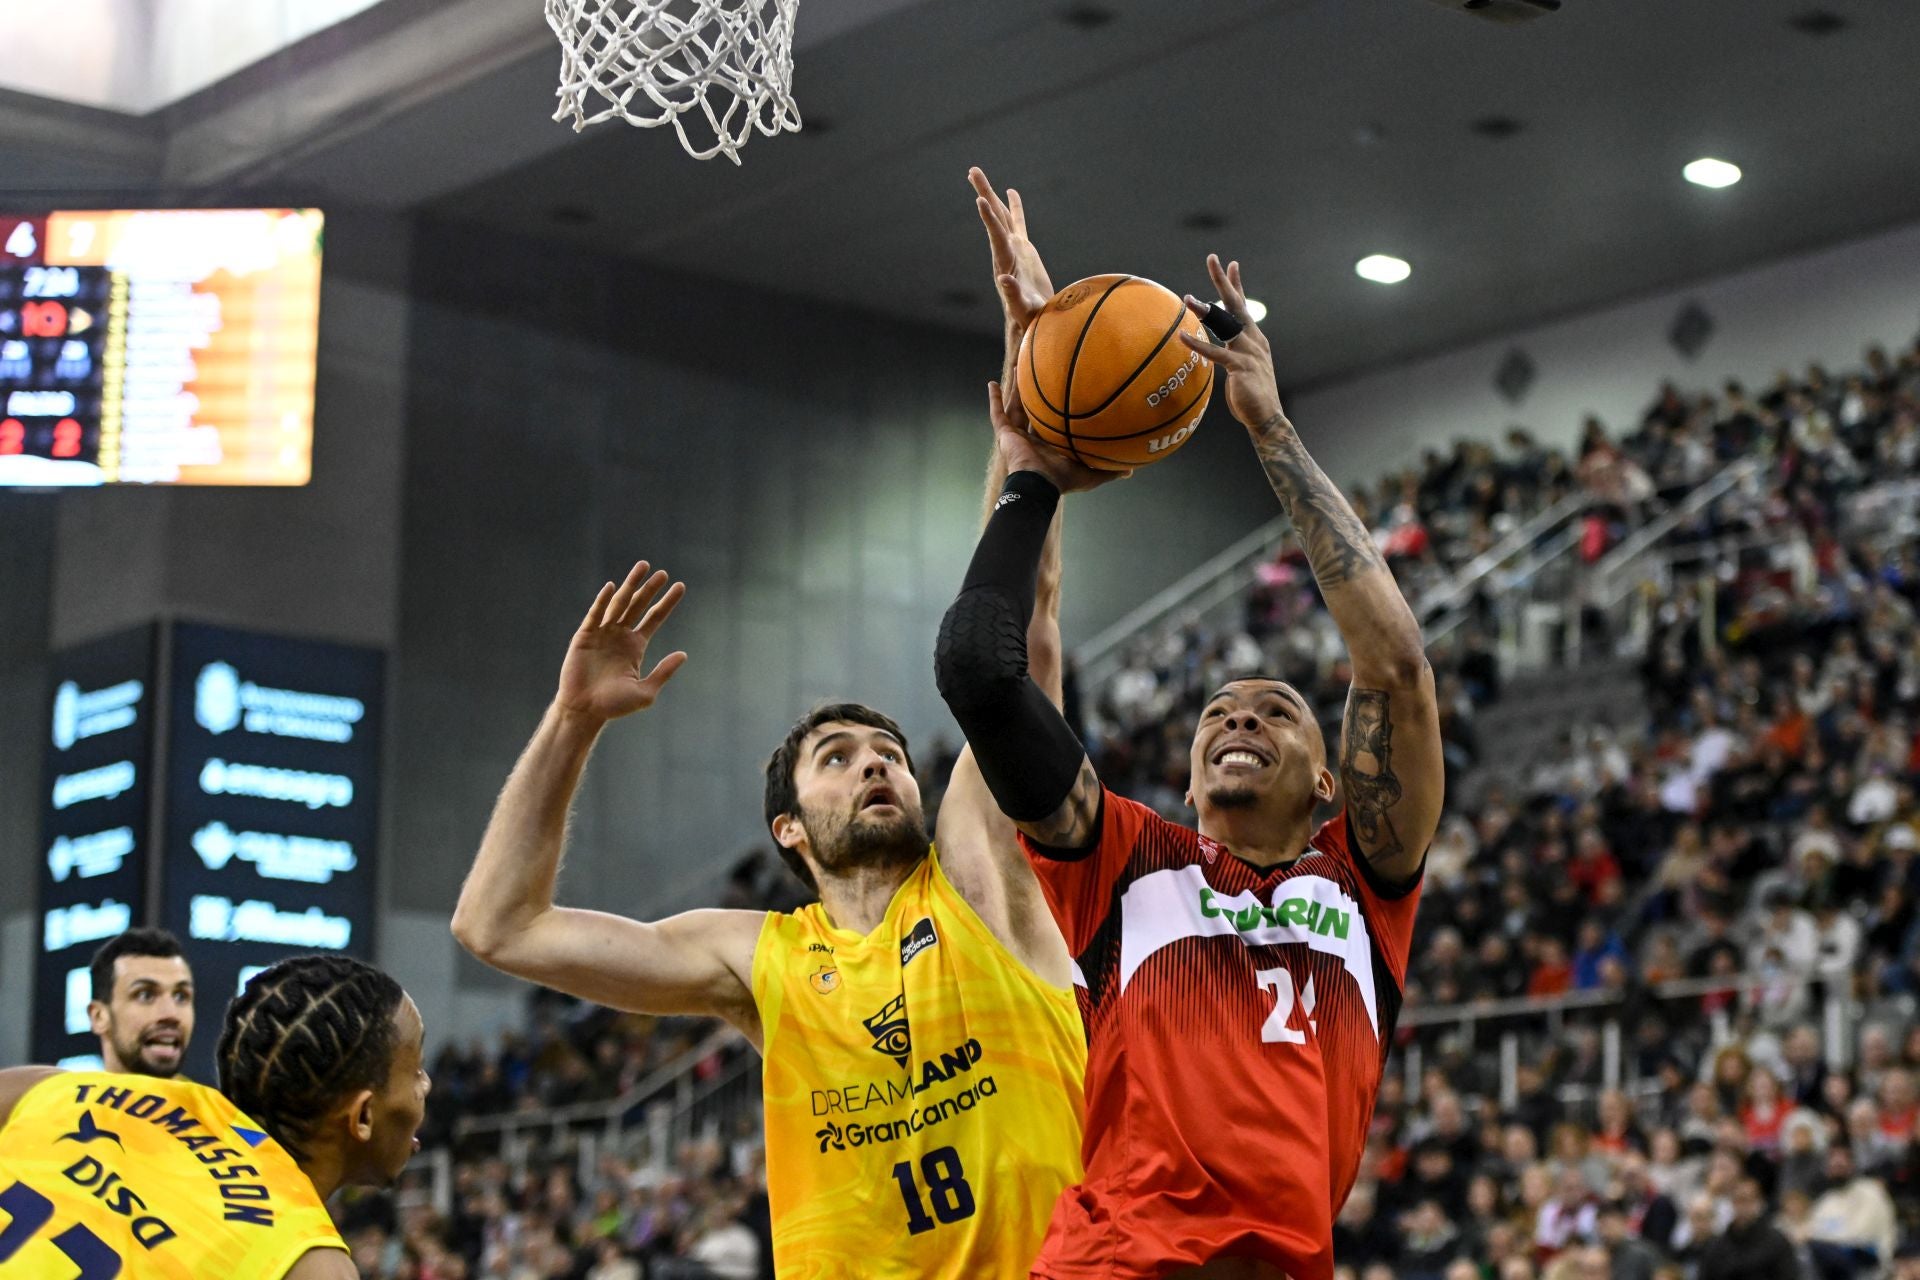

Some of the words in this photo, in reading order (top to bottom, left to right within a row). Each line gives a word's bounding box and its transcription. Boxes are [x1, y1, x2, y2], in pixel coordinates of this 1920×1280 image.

[1146, 350, 1200, 408] endesa
[75, 1084, 275, 1228] THOMASSON
[892, 1145, 977, 1237] 18
